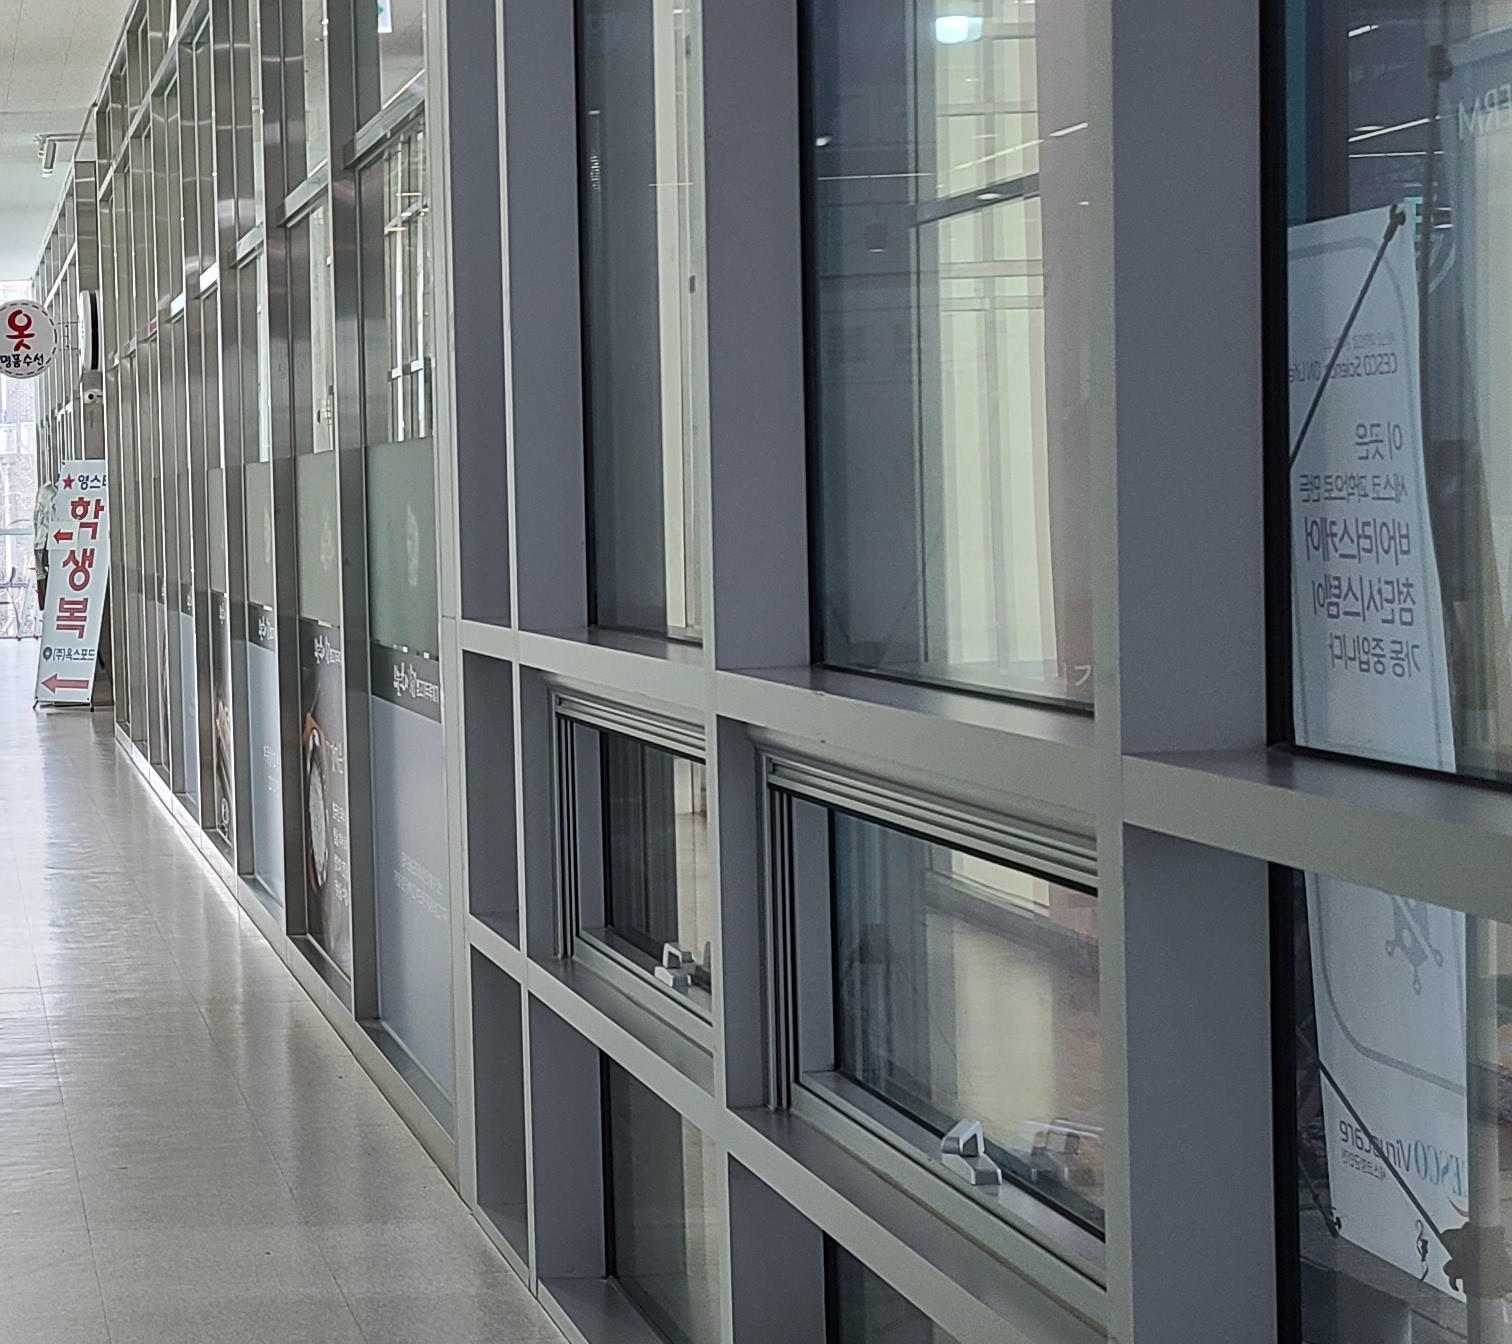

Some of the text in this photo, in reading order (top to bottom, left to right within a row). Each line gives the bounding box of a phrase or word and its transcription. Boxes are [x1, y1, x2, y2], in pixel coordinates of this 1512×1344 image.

[5, 309, 37, 352] 옷
[0, 353, 45, 369] 명품수선
[56, 496, 105, 640] 학생복
[53, 646, 95, 661] (주)옥스포드
